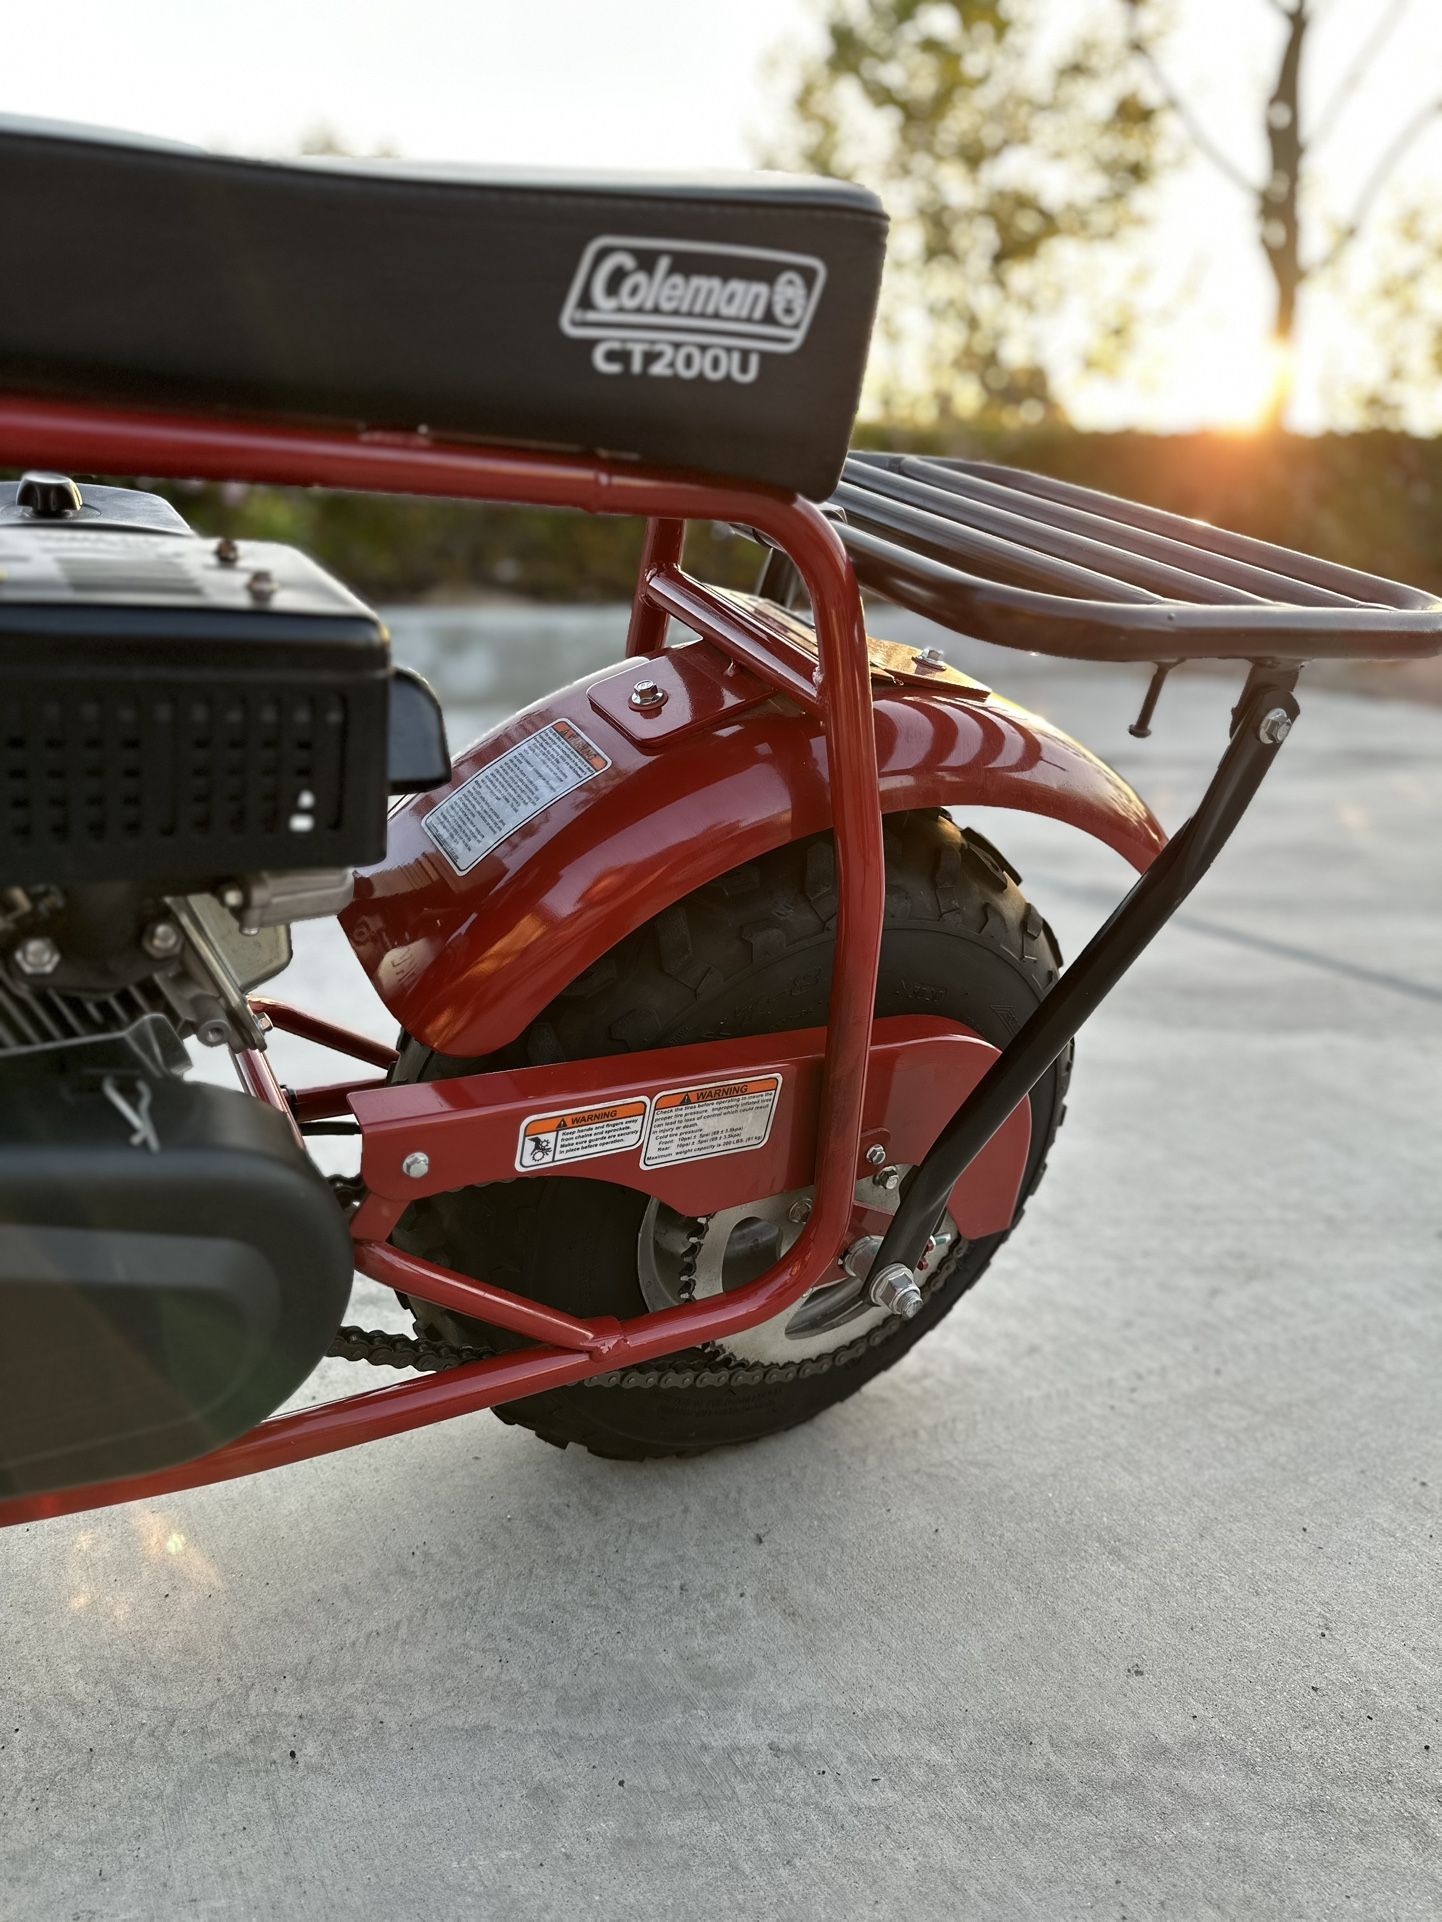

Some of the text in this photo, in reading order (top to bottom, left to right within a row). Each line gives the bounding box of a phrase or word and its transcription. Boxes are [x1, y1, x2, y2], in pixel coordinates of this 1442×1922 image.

[590, 251, 771, 321] Coleman
[591, 340, 760, 384] CT200U
[696, 1085, 748, 1100] WARNING
[572, 1110, 617, 1125] WARNING
